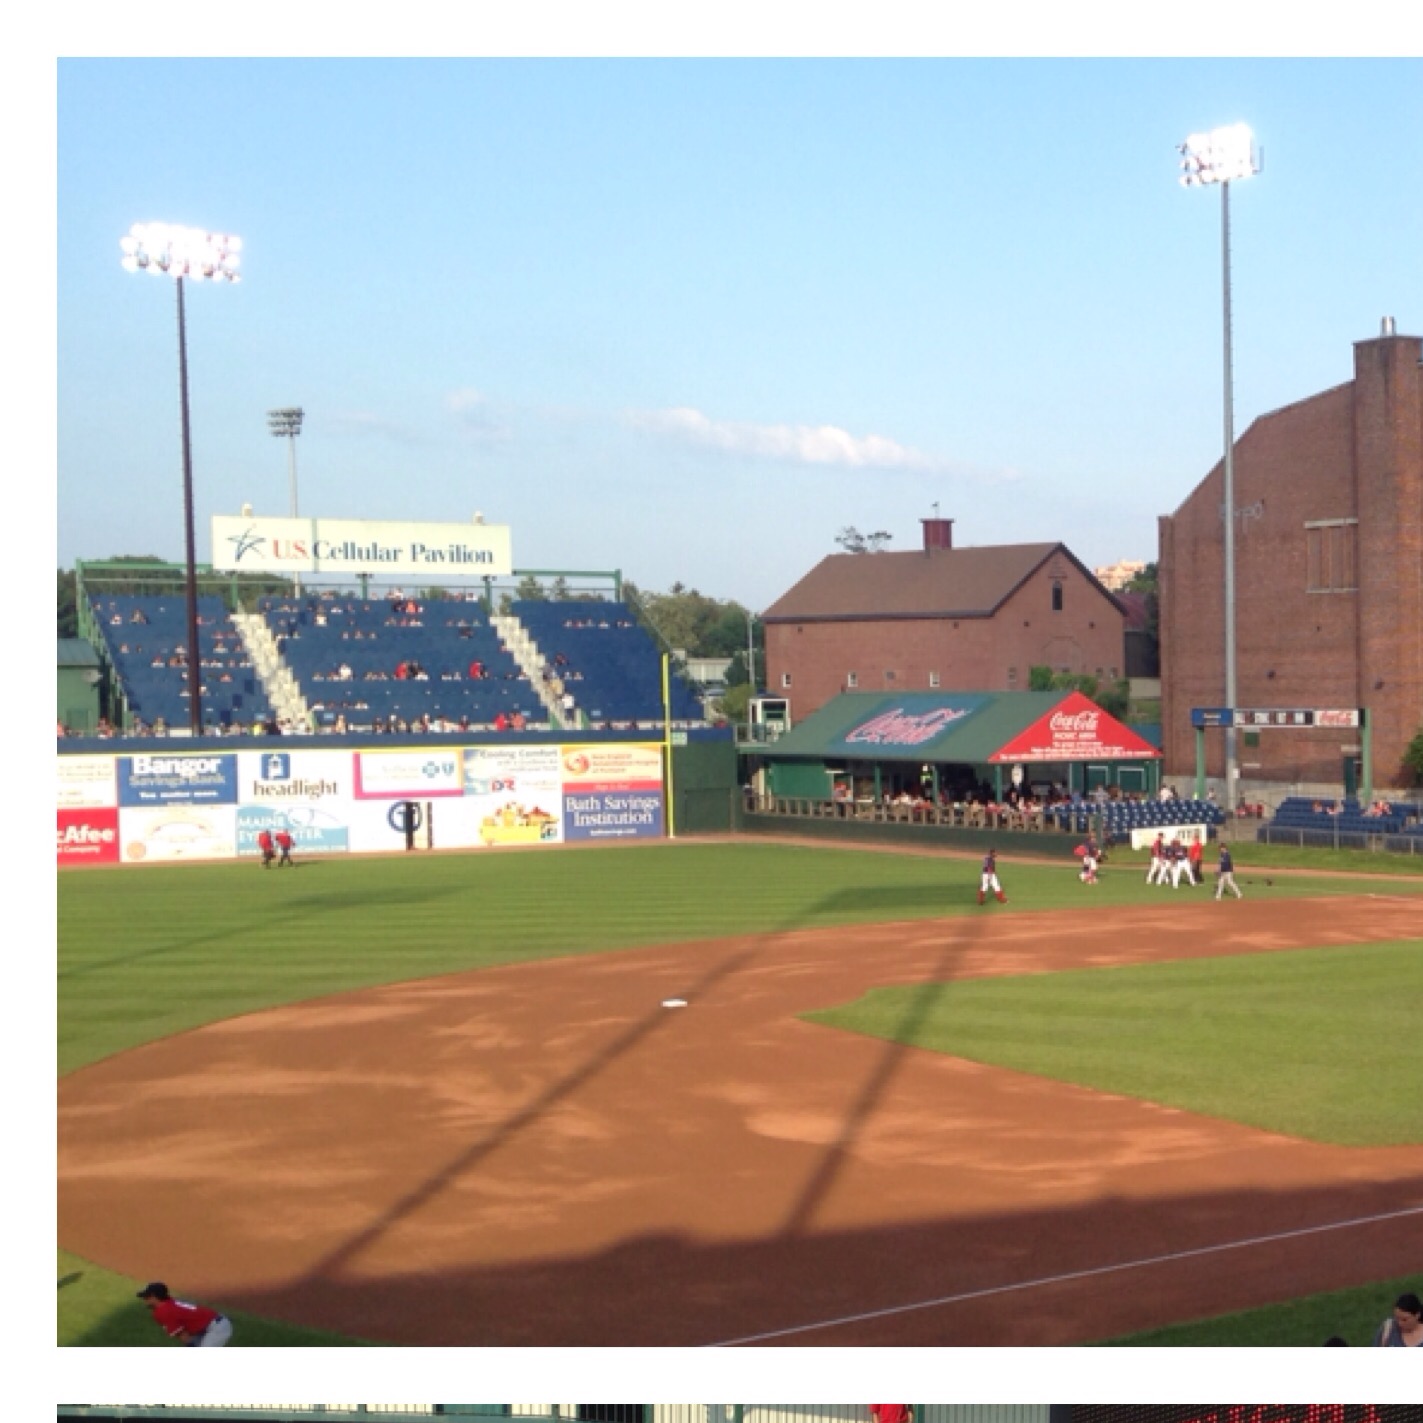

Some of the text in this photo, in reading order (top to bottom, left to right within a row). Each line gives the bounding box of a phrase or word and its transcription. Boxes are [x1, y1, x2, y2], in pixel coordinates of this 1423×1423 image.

[312, 540, 403, 562] Cellular
[410, 542, 494, 564] Pavilion
[132, 757, 222, 777] Bangor
[253, 778, 338, 799] headlight
[566, 794, 660, 812] Bath Savings
[574, 810, 655, 827] Institution
